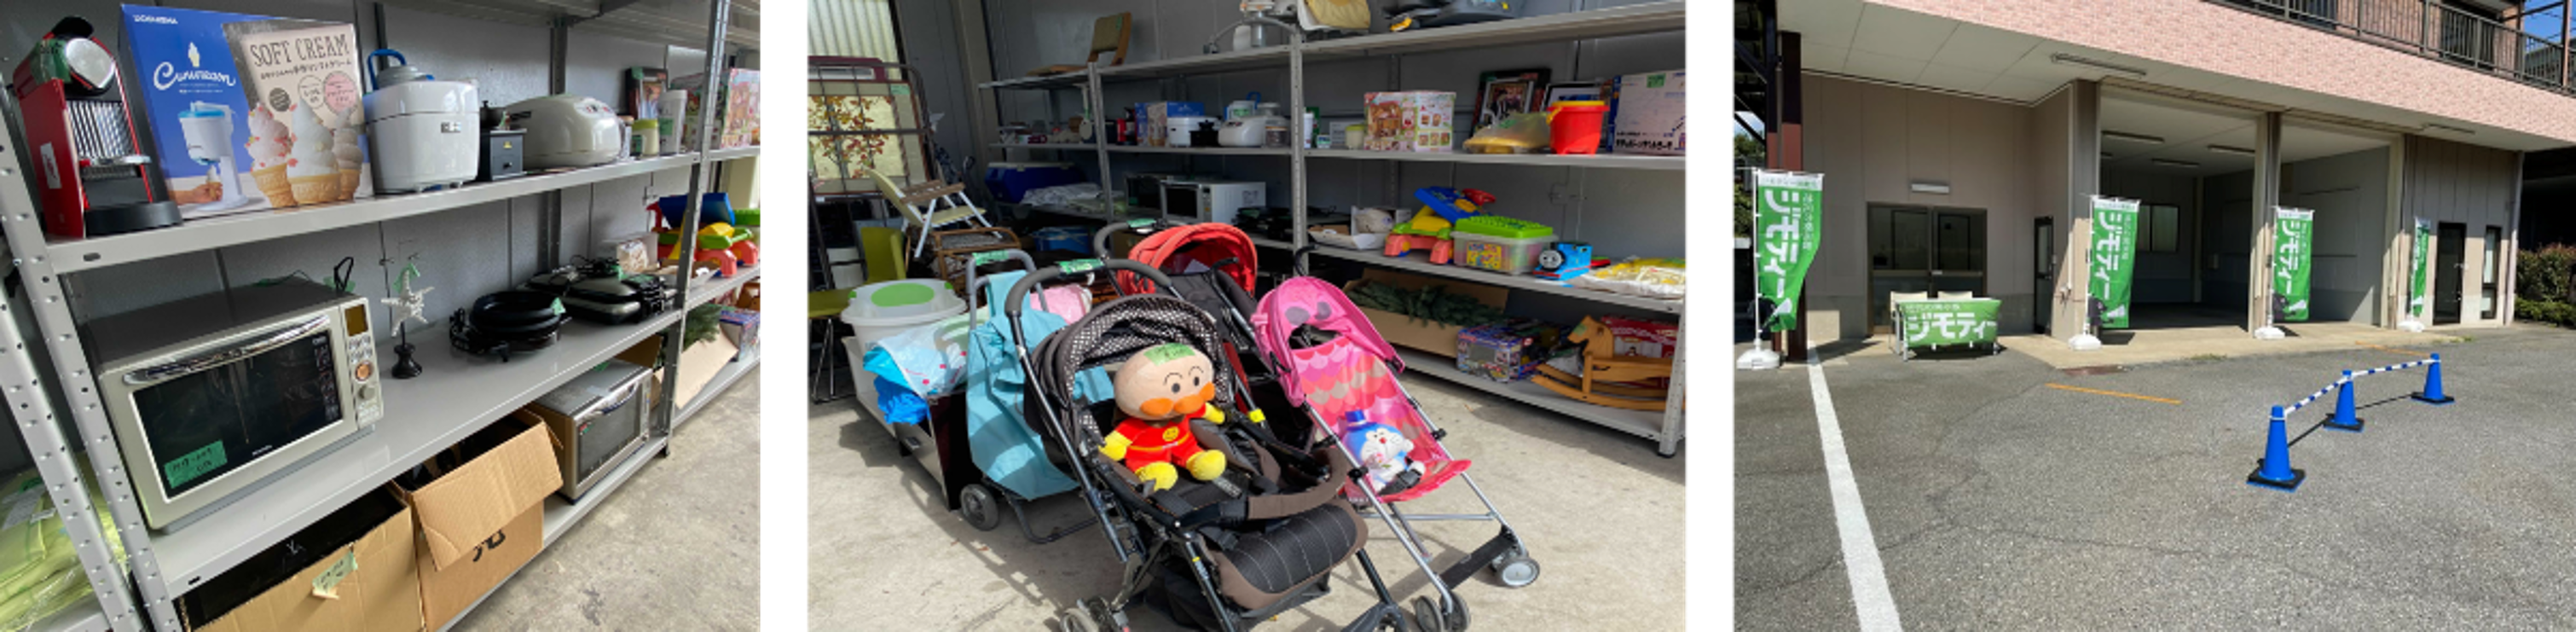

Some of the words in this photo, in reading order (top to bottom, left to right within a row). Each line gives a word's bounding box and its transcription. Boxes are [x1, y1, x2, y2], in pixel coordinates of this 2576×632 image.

[250, 40, 292, 67] SOFT
[296, 33, 351, 61] CREAM
[1764, 188, 1801, 299] ジモティー
[2096, 211, 2122, 299] ジモティー
[2278, 220, 2301, 294] ジモティー
[1907, 312, 1997, 342] ジモティー
